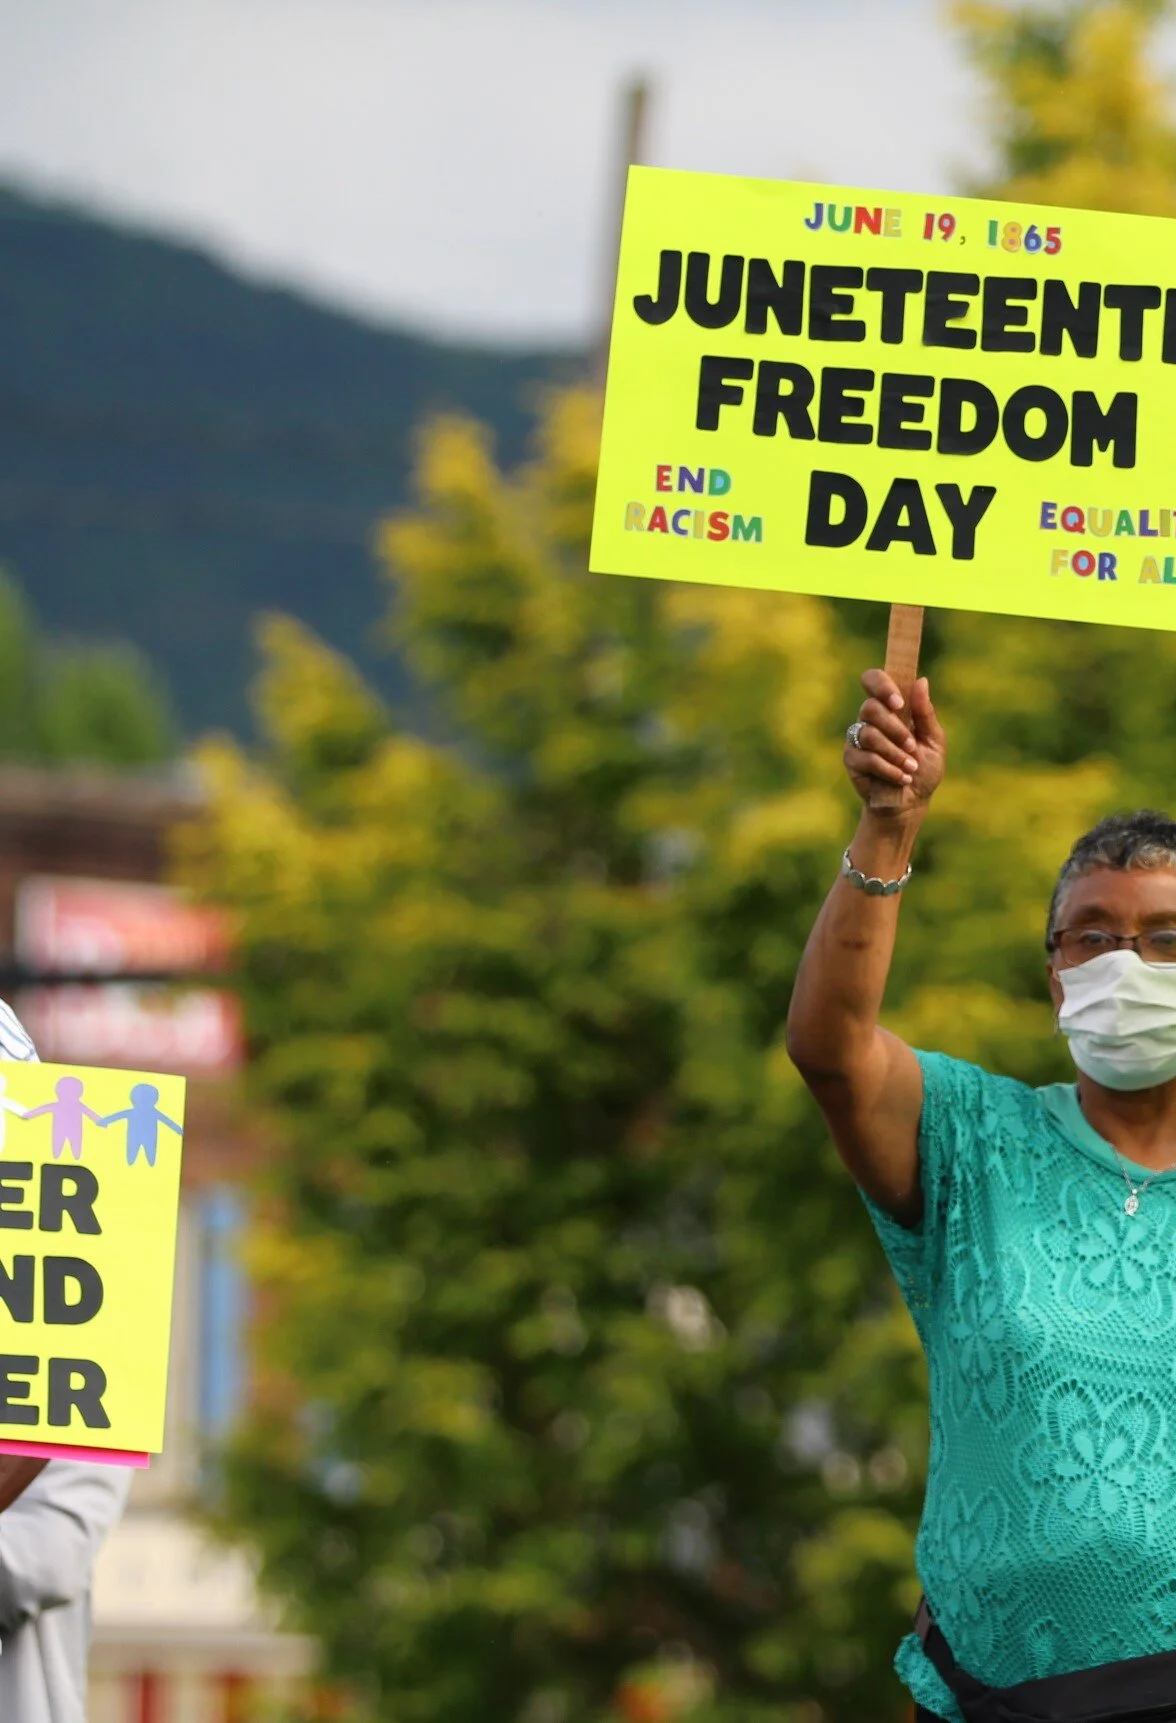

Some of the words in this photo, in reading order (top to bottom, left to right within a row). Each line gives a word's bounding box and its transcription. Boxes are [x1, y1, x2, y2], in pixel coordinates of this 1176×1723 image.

[804, 201, 902, 237] JUNE
[923, 212, 966, 246] 19,
[988, 219, 1062, 255] 1865
[696, 355, 1138, 468] FREEDOM
[655, 464, 731, 496] END
[624, 501, 763, 543] RACISM
[805, 470, 997, 560] DAY
[1050, 549, 1118, 581] FOR
